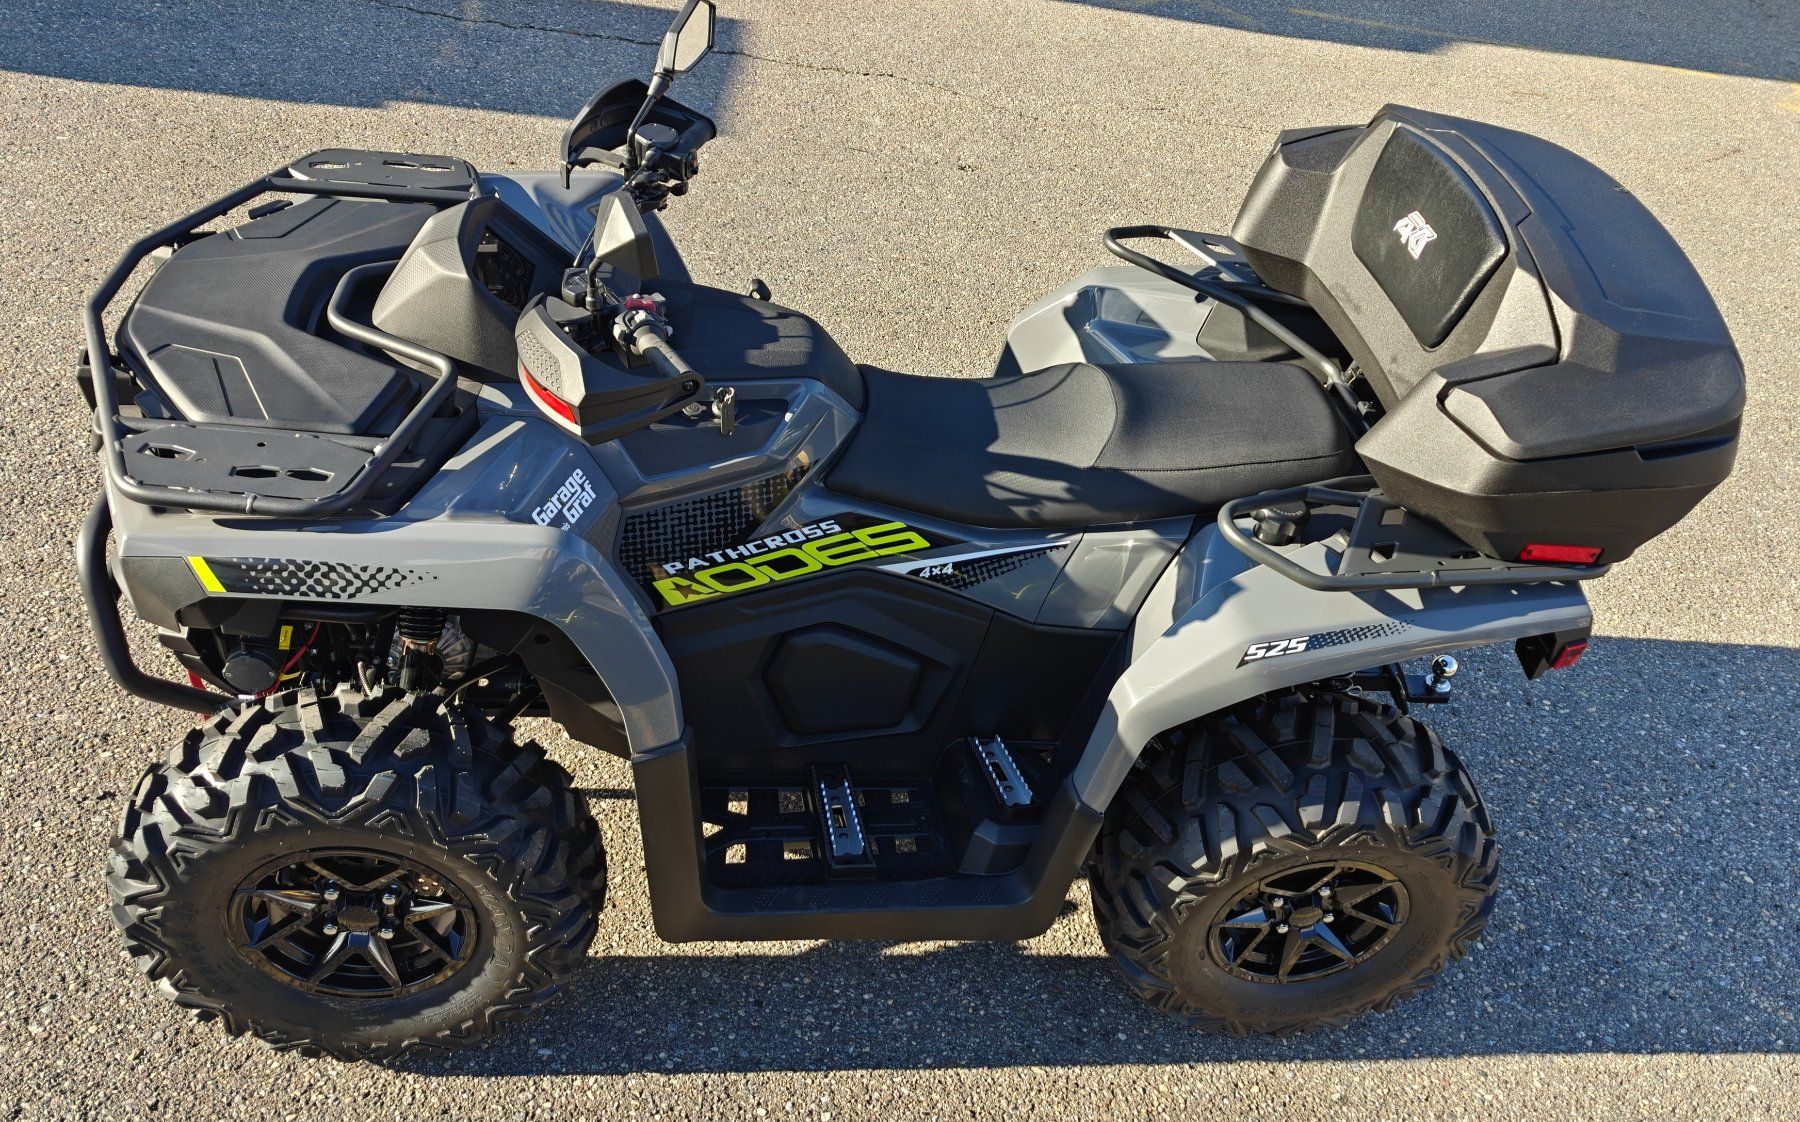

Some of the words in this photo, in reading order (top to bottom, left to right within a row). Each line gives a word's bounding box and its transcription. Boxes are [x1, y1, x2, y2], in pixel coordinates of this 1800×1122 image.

[531, 468, 587, 526] Garage
[562, 479, 597, 524] Graf
[662, 519, 842, 575] PATHCROSS
[1243, 636, 1310, 660] 525
